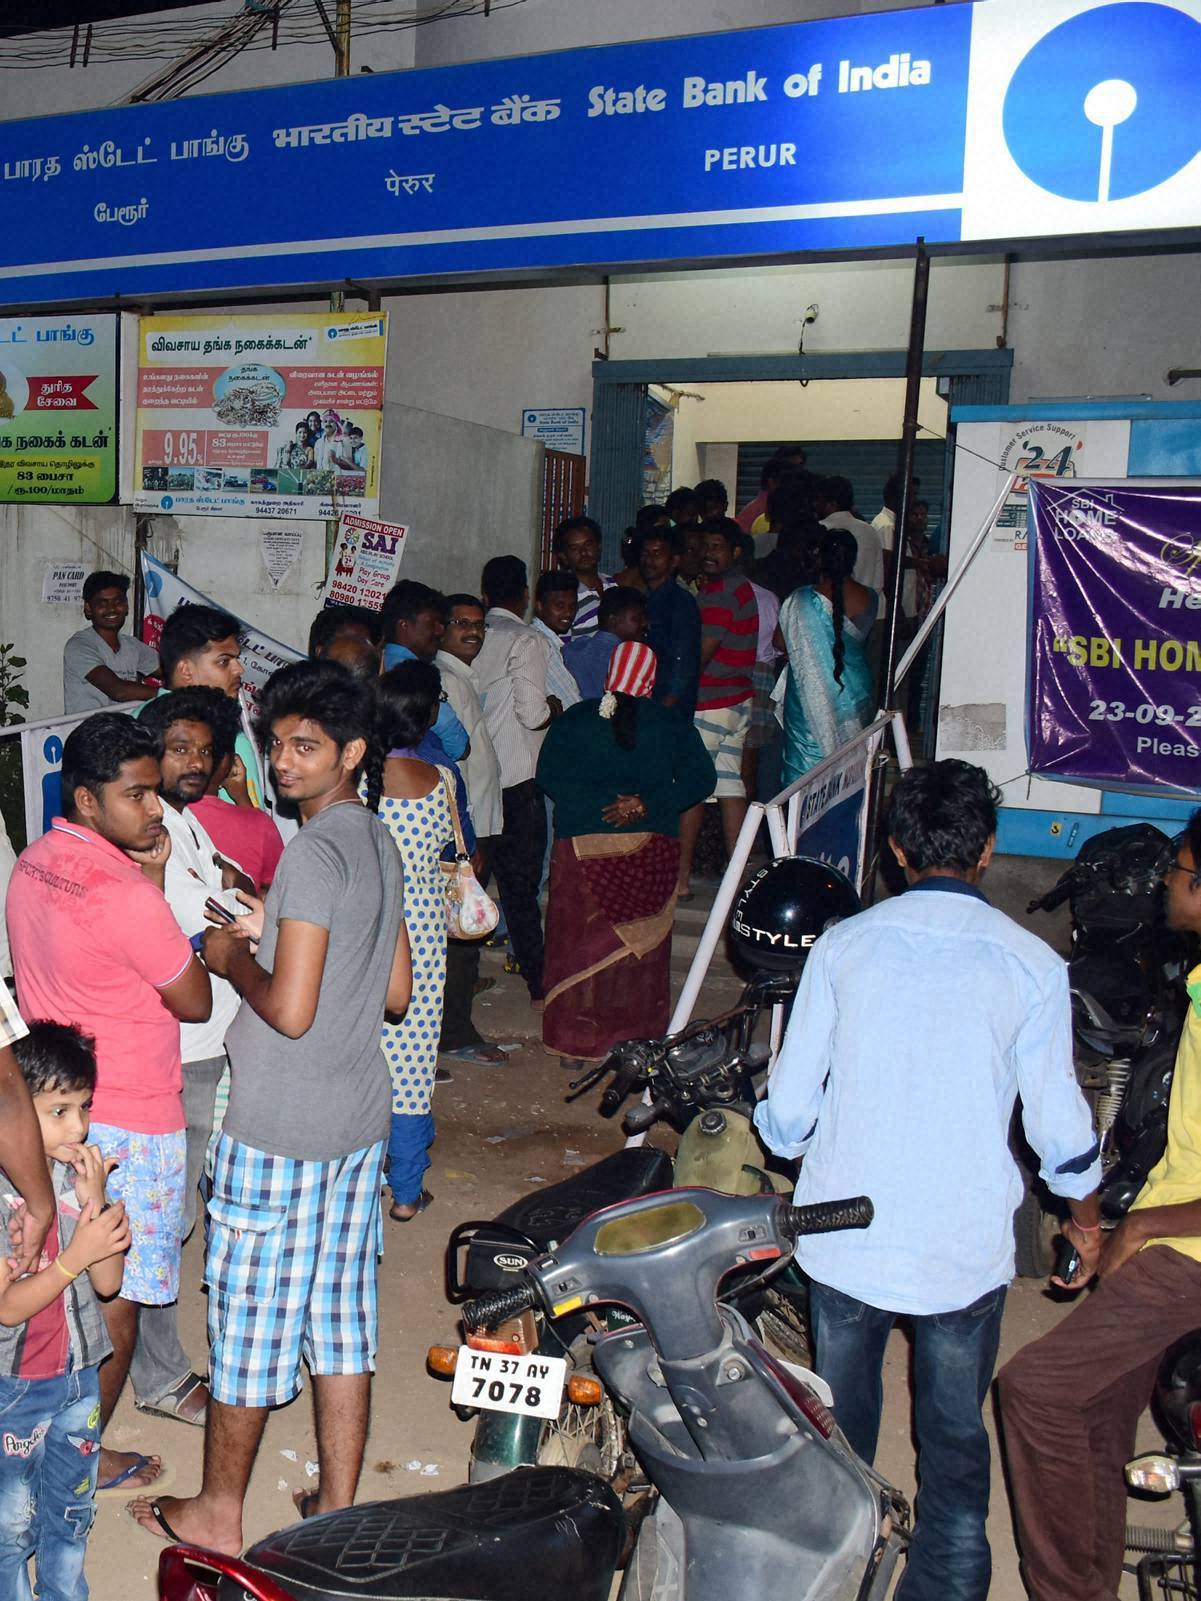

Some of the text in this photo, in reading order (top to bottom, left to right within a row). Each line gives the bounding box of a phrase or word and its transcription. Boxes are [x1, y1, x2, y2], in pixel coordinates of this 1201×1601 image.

[588, 53, 932, 118] State Bank of India
[273, 91, 561, 149] भारतीय स्टेट बैंक
[3, 129, 249, 184] பாரத ஸ்டேட் பாங்கு
[703, 142, 797, 171] PERUR
[93, 197, 149, 226] பேரூர்
[36, 324, 95, 346] பாங்கு
[151, 336, 201, 353] விவசாய
[202, 336, 232, 356] தங்க
[40, 381, 73, 395] துரித
[37, 396, 77, 408] சேவை
[15, 430, 67, 452] நகைக்
[1016, 424, 1045, 440] Service
[1046, 423, 1077, 441] Support
[164, 431, 198, 465] 9.95
[17, 471, 34, 481] 83
[255, 506, 275, 516] 94437
[1071, 498, 1095, 509] SBI
[344, 516, 404, 537] ADMISSION OPEN
[1054, 510, 1117, 526] HOME
[361, 531, 400, 555] SAI
[740, 922, 817, 948] STYLE
[498, 1256, 524, 1267] SUN
[470, 1355, 550, 1380] TN 37 AY
[472, 1377, 542, 1407] 7078
